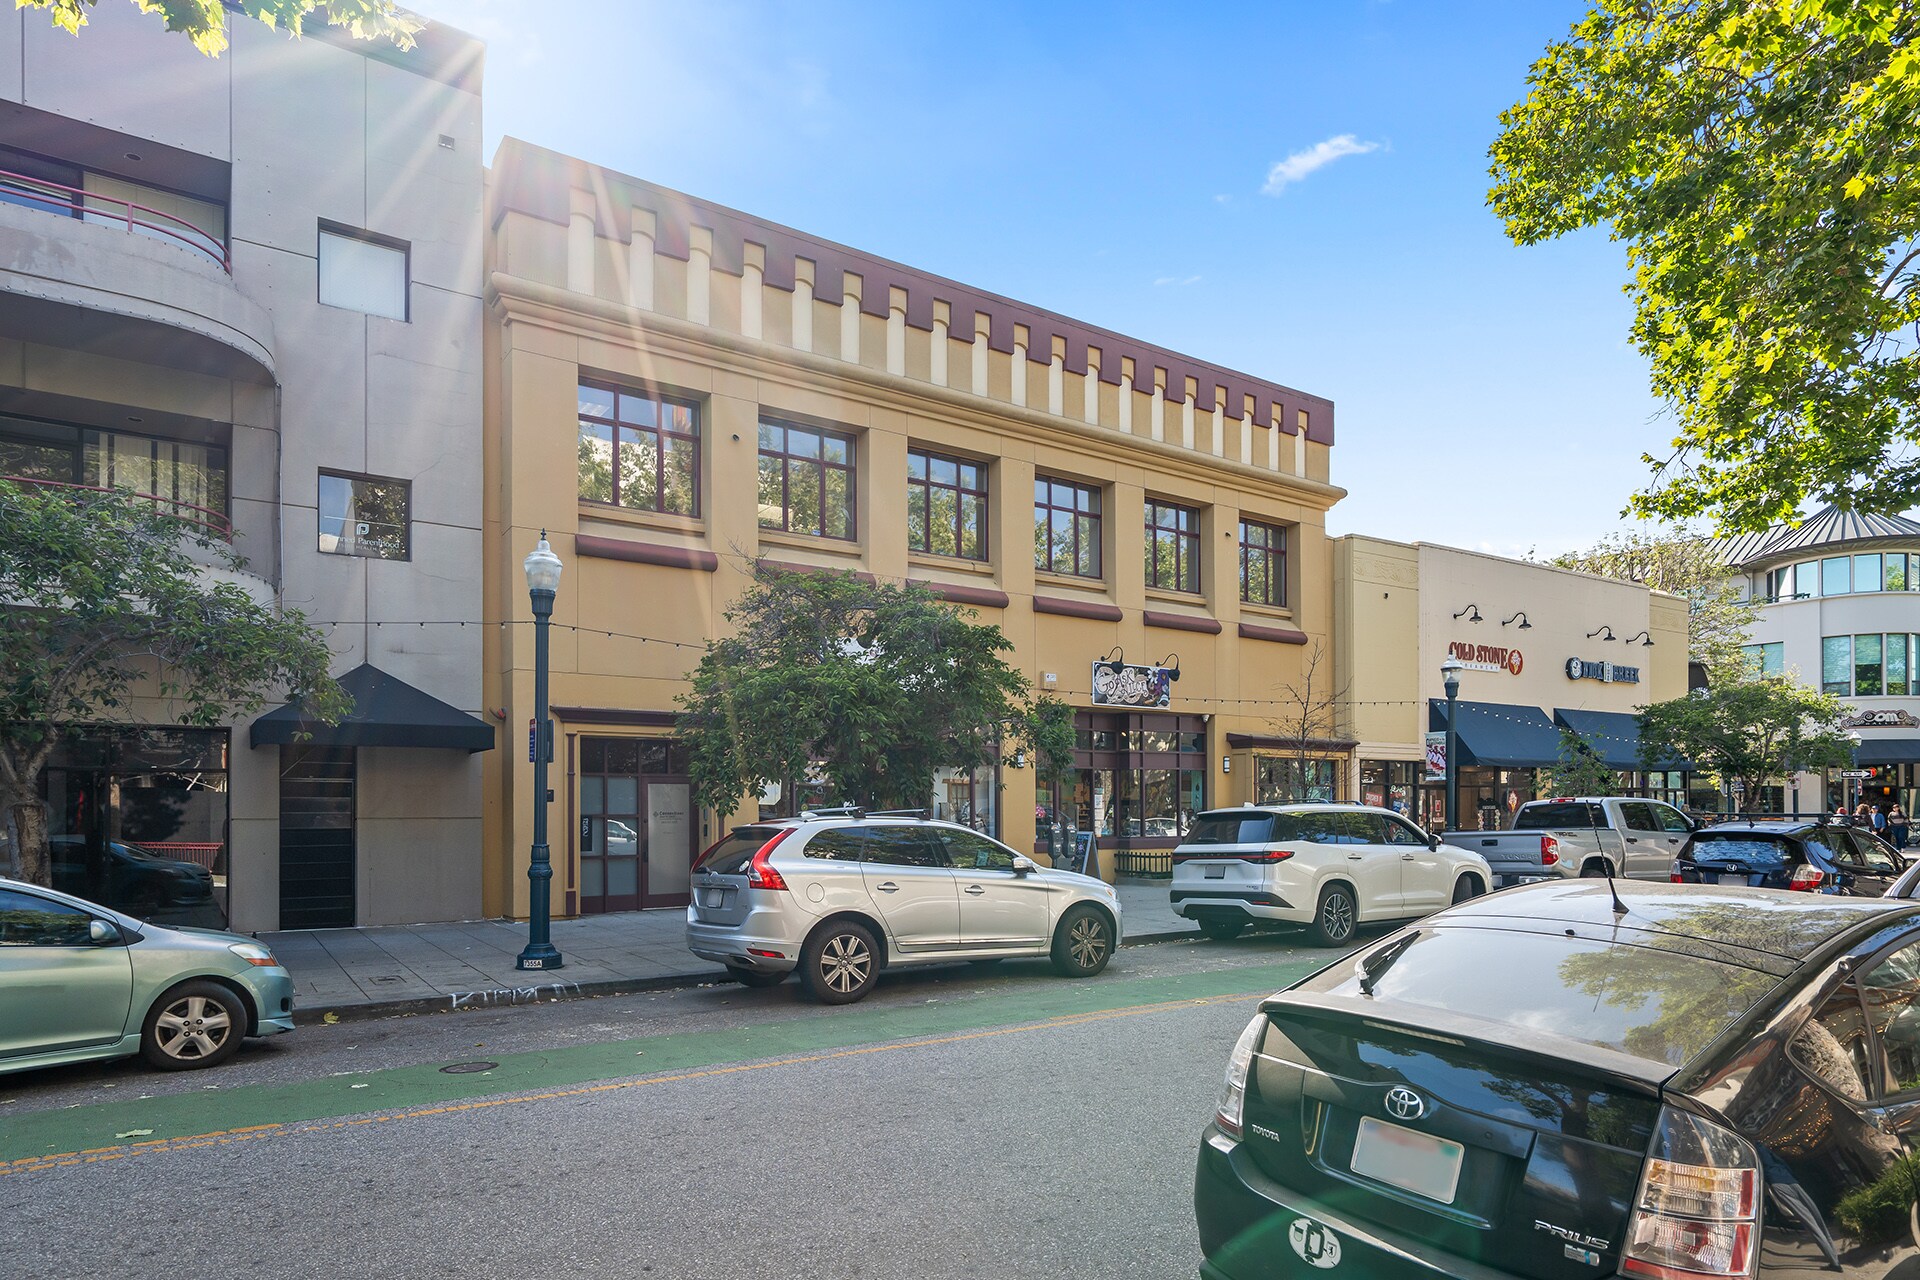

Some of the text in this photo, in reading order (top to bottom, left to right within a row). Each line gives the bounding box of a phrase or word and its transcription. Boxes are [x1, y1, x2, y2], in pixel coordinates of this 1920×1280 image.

[1449, 641, 1508, 669] COLD STONE
[1251, 1123, 1281, 1143] TOYOTA
[1534, 1219, 1610, 1250] PRIUS
